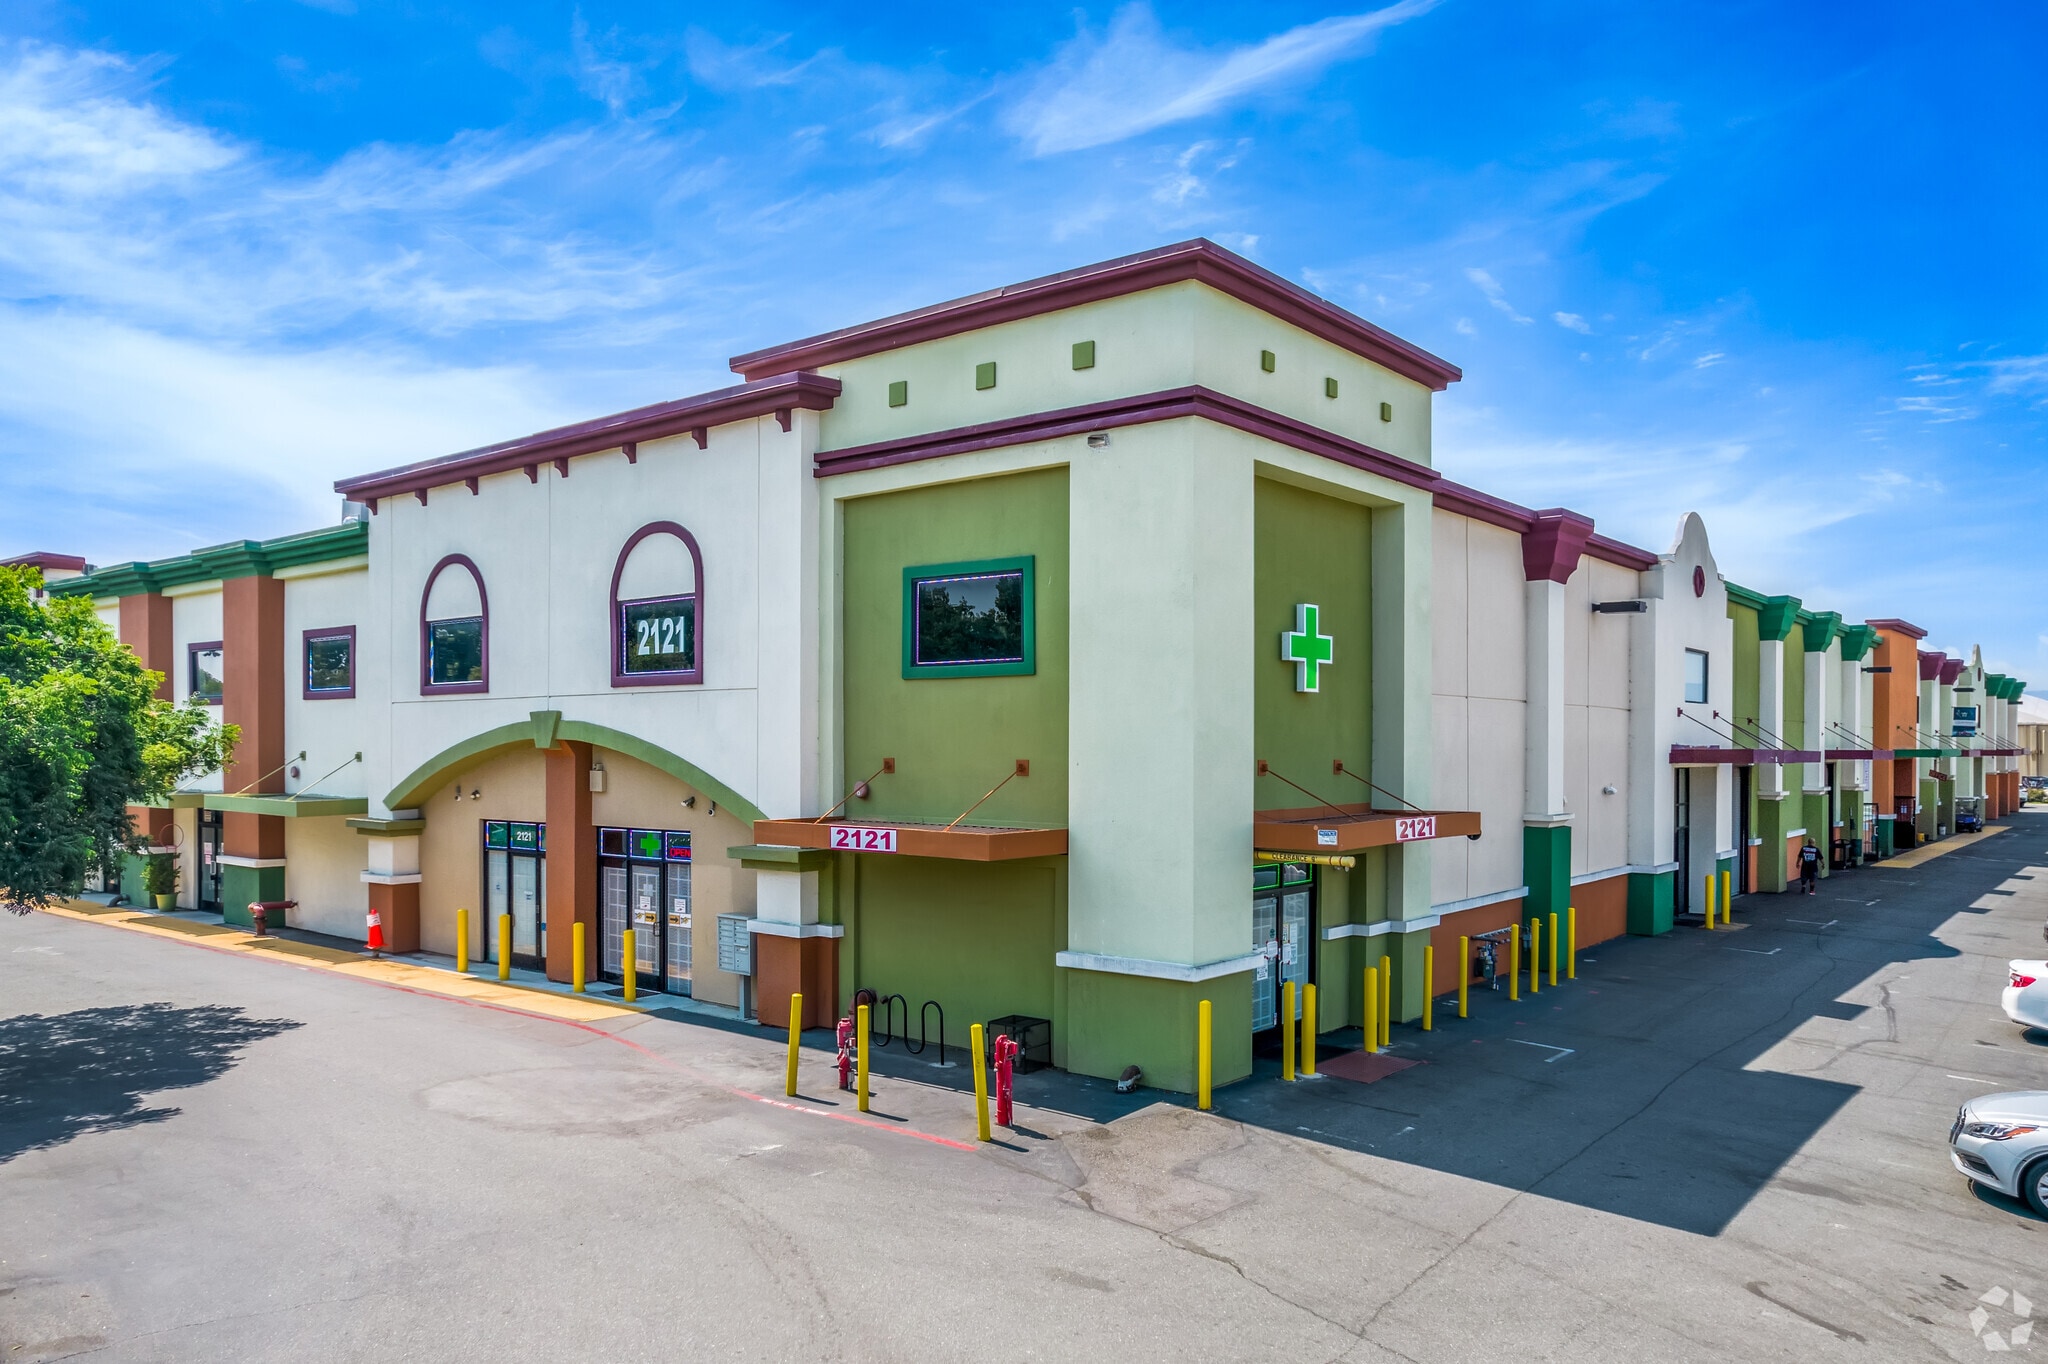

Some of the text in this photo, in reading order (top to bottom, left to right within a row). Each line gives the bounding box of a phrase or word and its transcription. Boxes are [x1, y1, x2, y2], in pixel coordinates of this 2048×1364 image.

[637, 615, 685, 656] 2121
[1400, 817, 1433, 839] 2121
[516, 831, 532, 842] 2121
[835, 828, 892, 850] 2121
[669, 847, 691, 858] OPEN
[1271, 852, 1308, 863] CLEARANCE
